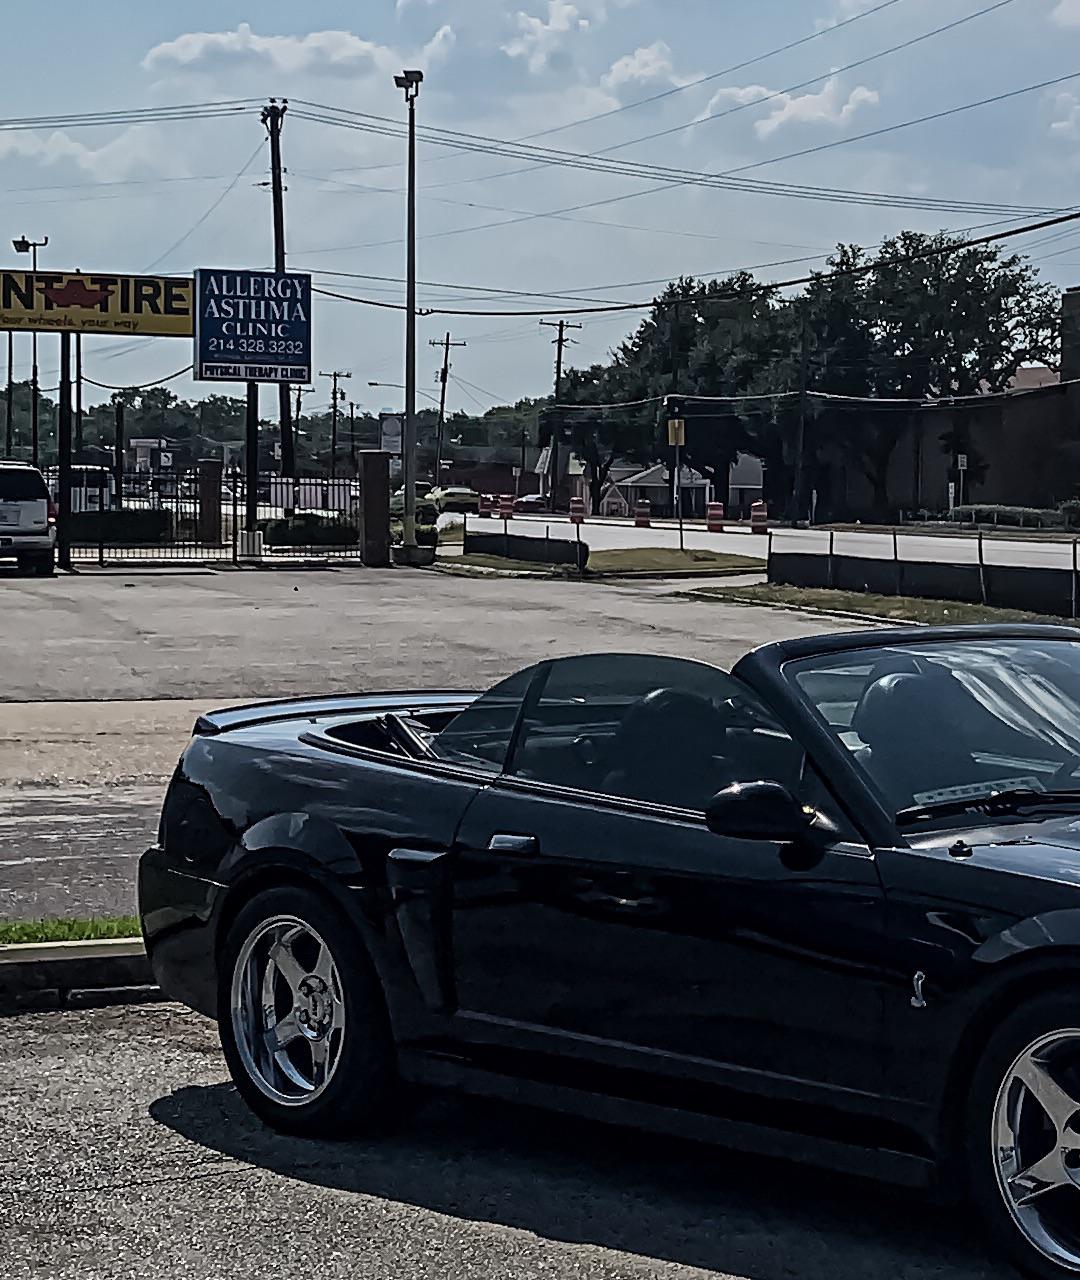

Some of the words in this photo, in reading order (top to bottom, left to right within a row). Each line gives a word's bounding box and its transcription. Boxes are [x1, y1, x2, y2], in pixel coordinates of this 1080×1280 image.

[90, 278, 189, 315] TIRE
[205, 276, 305, 299] ALLERGY
[205, 299, 306, 321] ASTHMA
[114, 320, 139, 330] way
[222, 322, 291, 337] CLINIC
[244, 366, 278, 378] THERAPY
